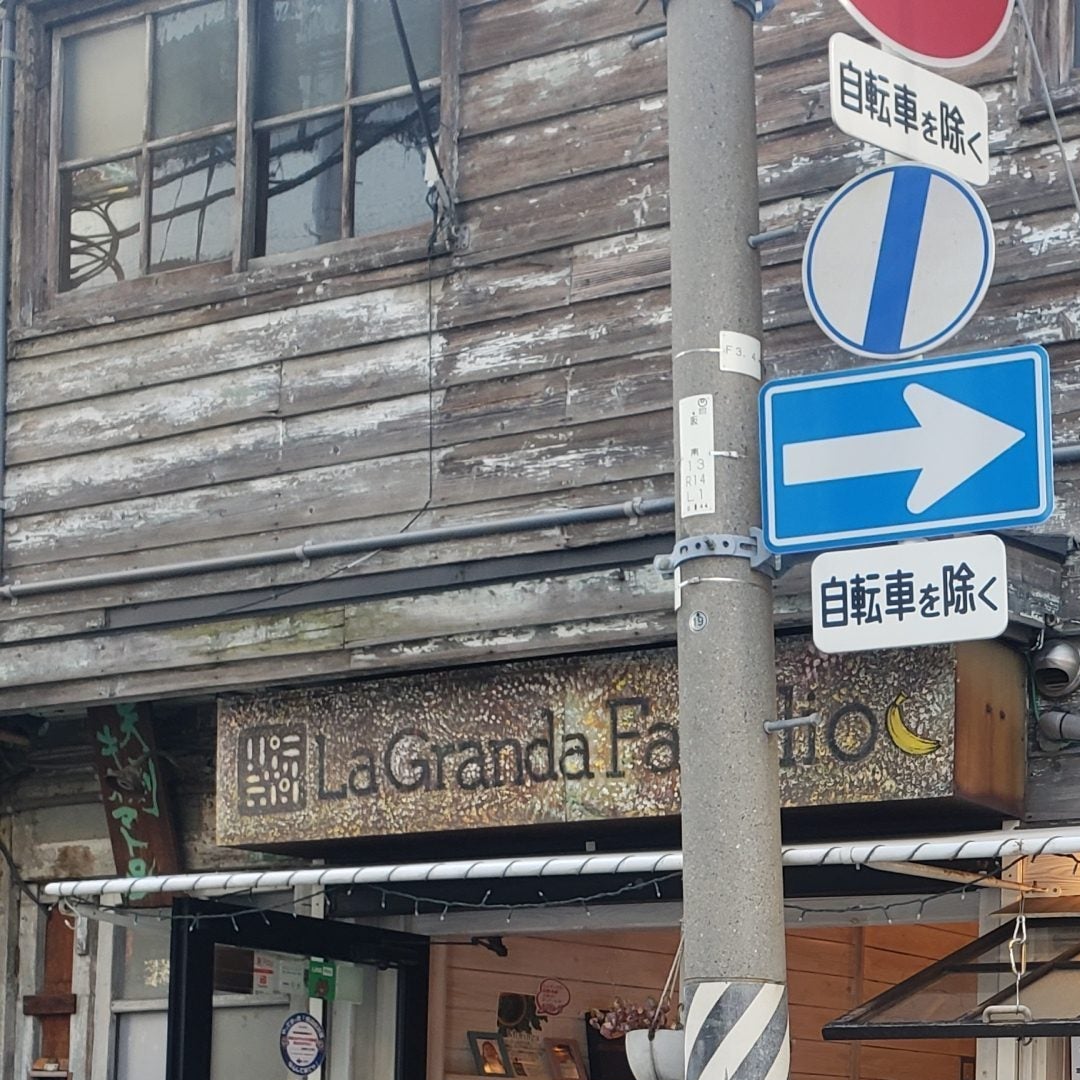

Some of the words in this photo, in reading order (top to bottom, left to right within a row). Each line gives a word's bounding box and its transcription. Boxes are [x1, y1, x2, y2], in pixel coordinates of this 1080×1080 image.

[839, 59, 982, 164] 自転車を除く
[820, 562, 998, 628] 自転車を除く
[608, 685, 878, 779] Falio
